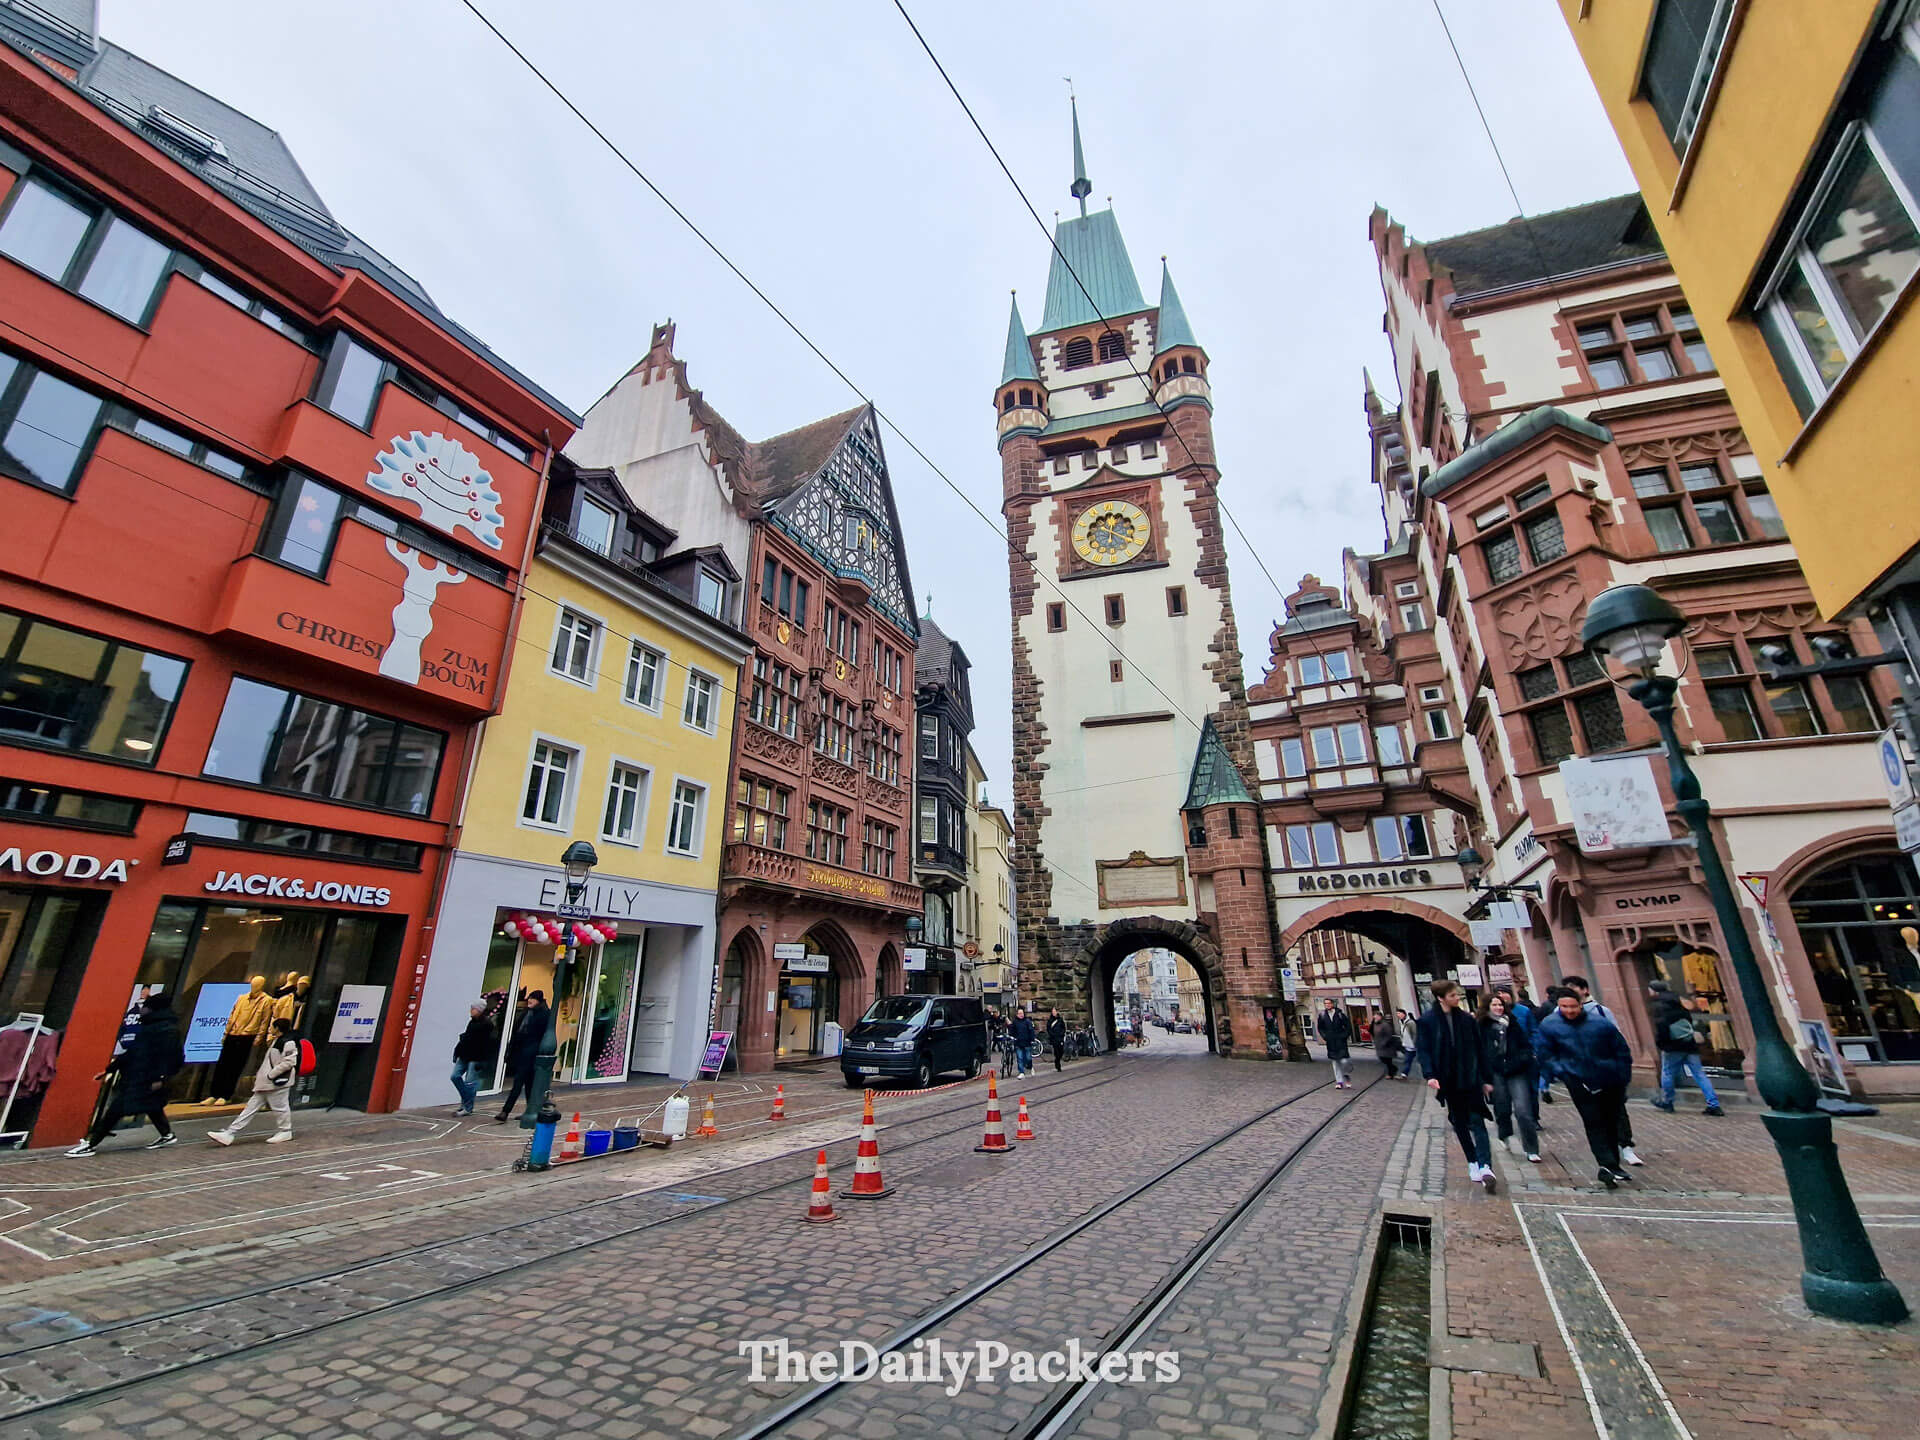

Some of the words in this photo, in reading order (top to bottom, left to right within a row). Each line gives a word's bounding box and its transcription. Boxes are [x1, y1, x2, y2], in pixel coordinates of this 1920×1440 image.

[277, 611, 384, 660] CHRIESI
[422, 660, 488, 695] BOUM
[441, 648, 489, 677] ZUM
[205, 871, 391, 906] JACK&JONES
[540, 878, 640, 915] EMILY
[1298, 867, 1432, 892] McDonald's
[1615, 894, 1681, 909] OLYMP
